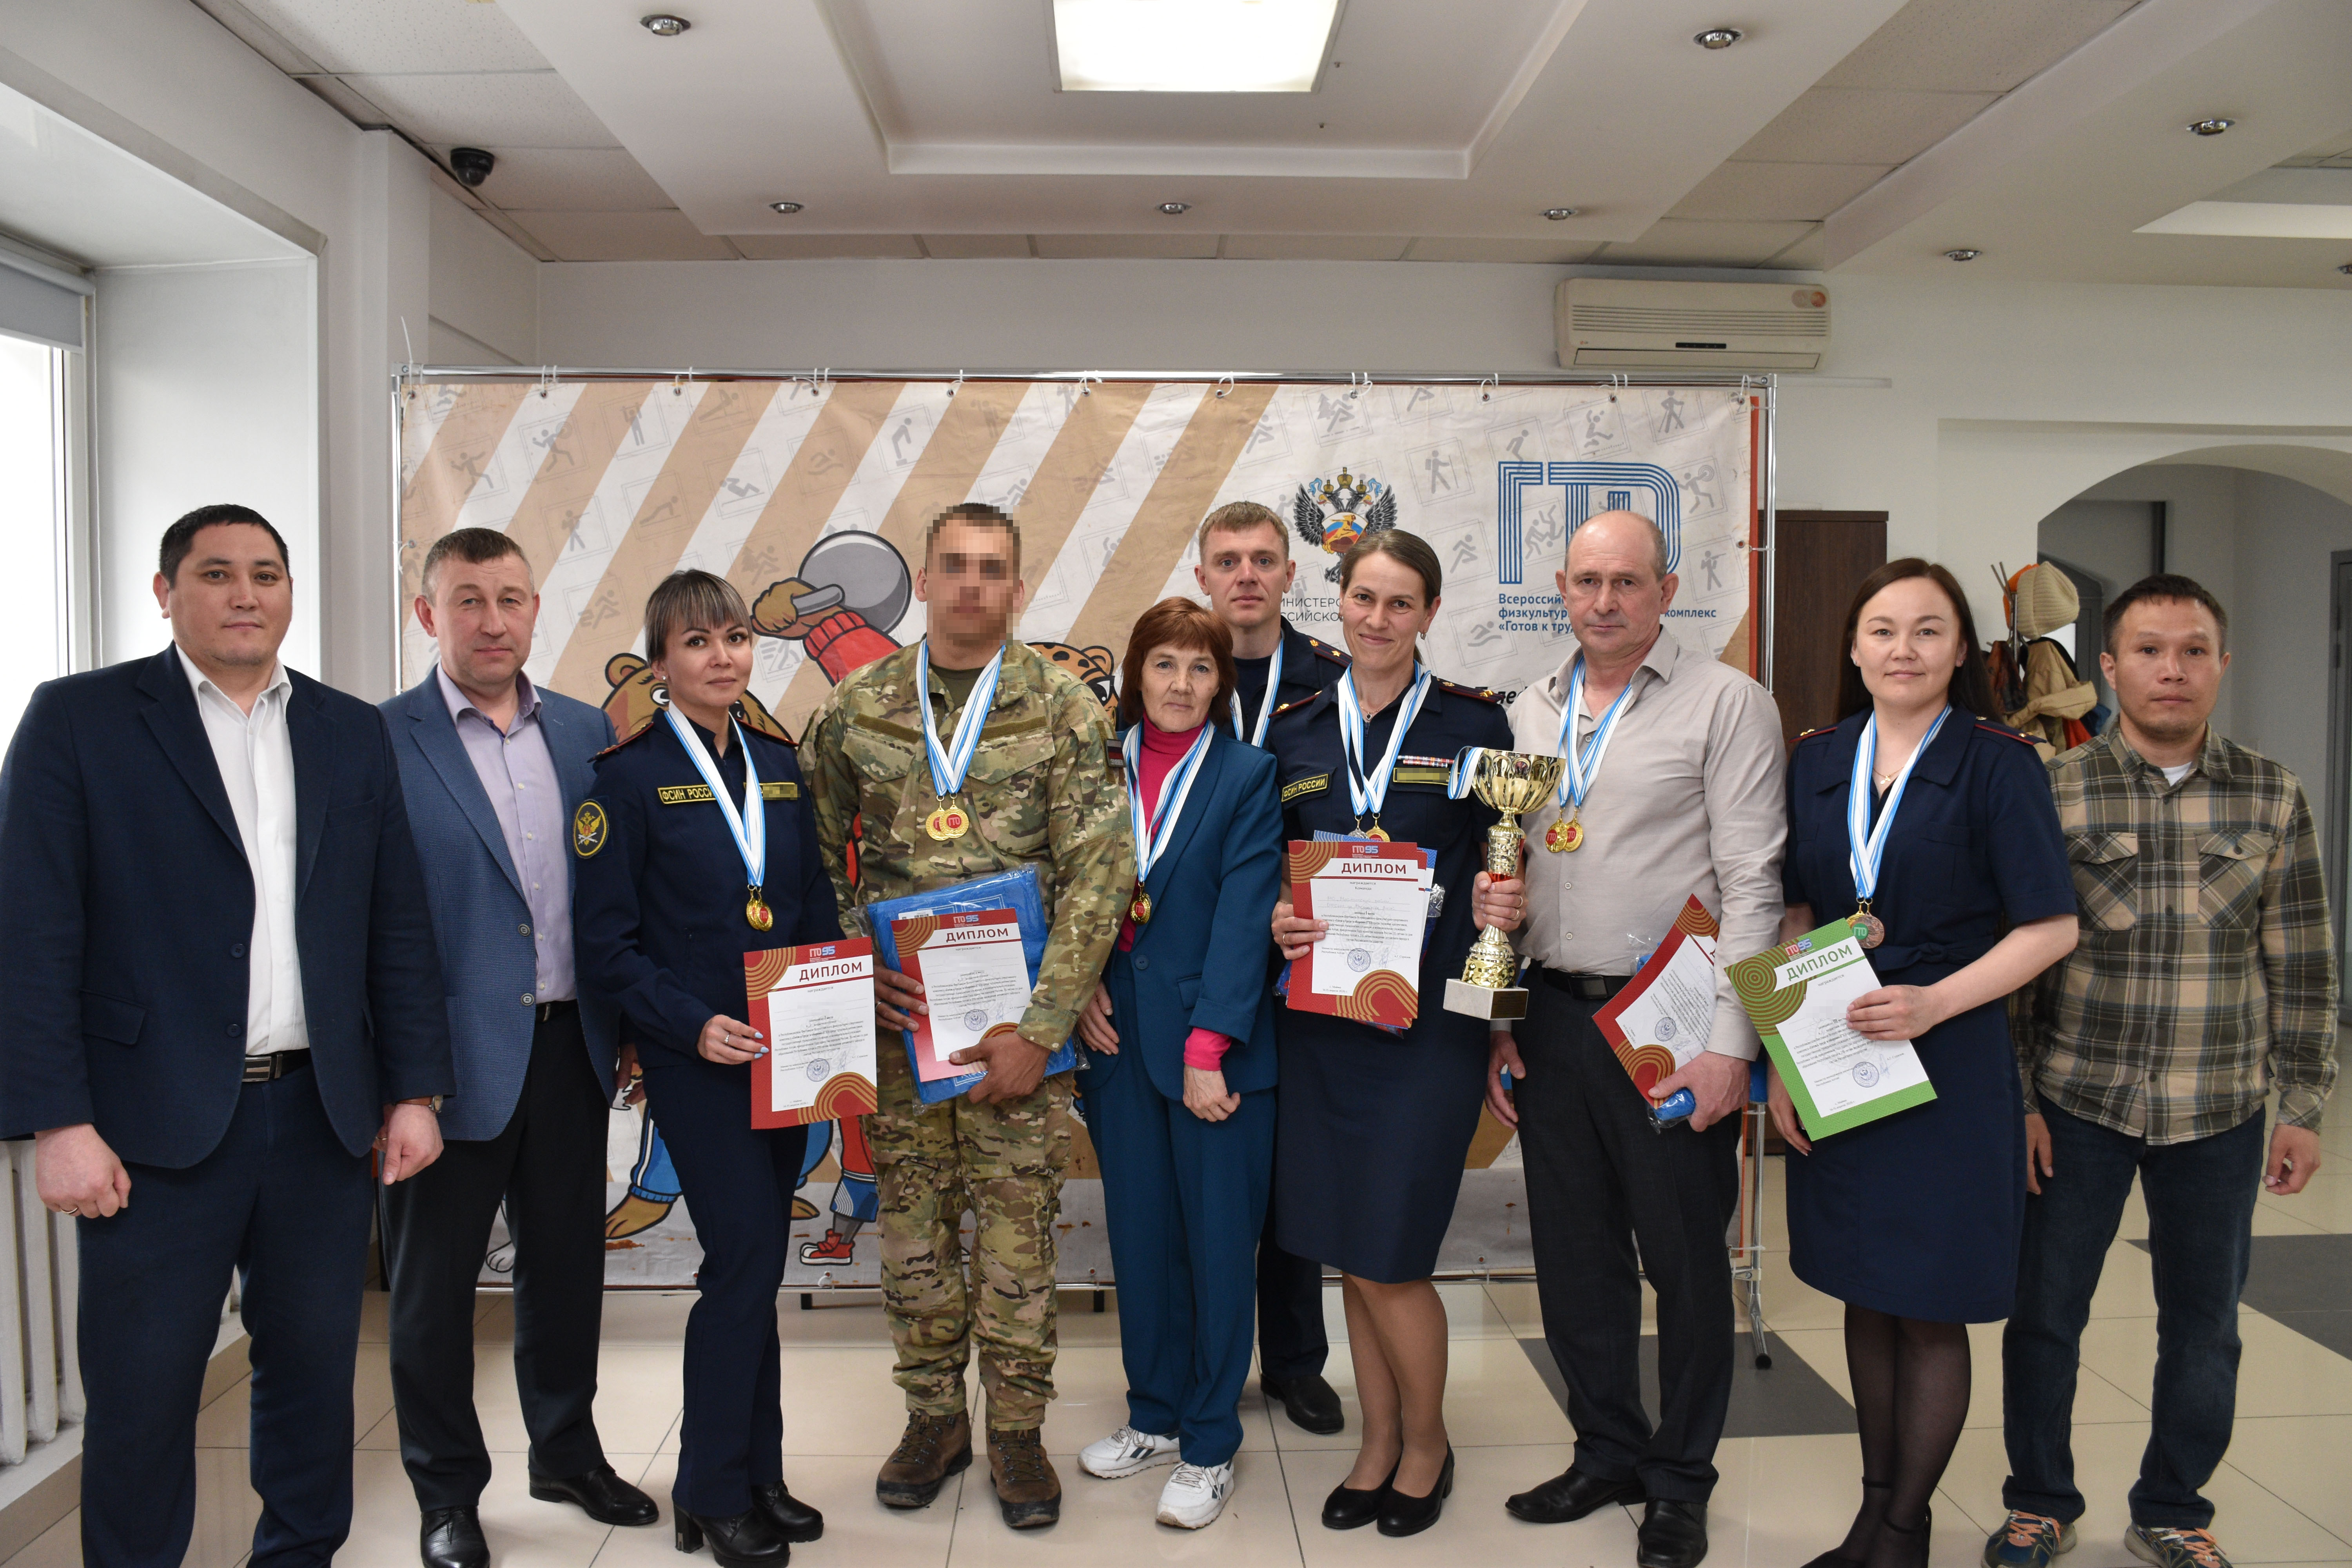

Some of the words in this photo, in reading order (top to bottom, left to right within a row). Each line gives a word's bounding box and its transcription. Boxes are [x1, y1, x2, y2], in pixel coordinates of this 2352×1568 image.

[1498, 607, 1569, 620] физкультур
[1664, 609, 1717, 617] комплекс
[1499, 621, 1538, 631] «Готов
[1551, 623, 1573, 634] тру
[662, 789, 686, 801] ФСИН
[687, 787, 712, 799] РОССИ
[1284, 785, 1298, 797] ФСИН
[1298, 778, 1325, 791] РОССИИ
[948, 817, 960, 826] ГТО
[1547, 833, 1557, 842] ГТО
[1341, 863, 1406, 874] ДИПЛОМ
[1136, 905, 1144, 913] ГТО
[946, 928, 1009, 943] ДИПЛОМ
[1853, 927, 1867, 936] ГТО
[1786, 945, 1853, 982] ДИПЛОМ
[799, 962, 862, 982] ДИПЛОМ
